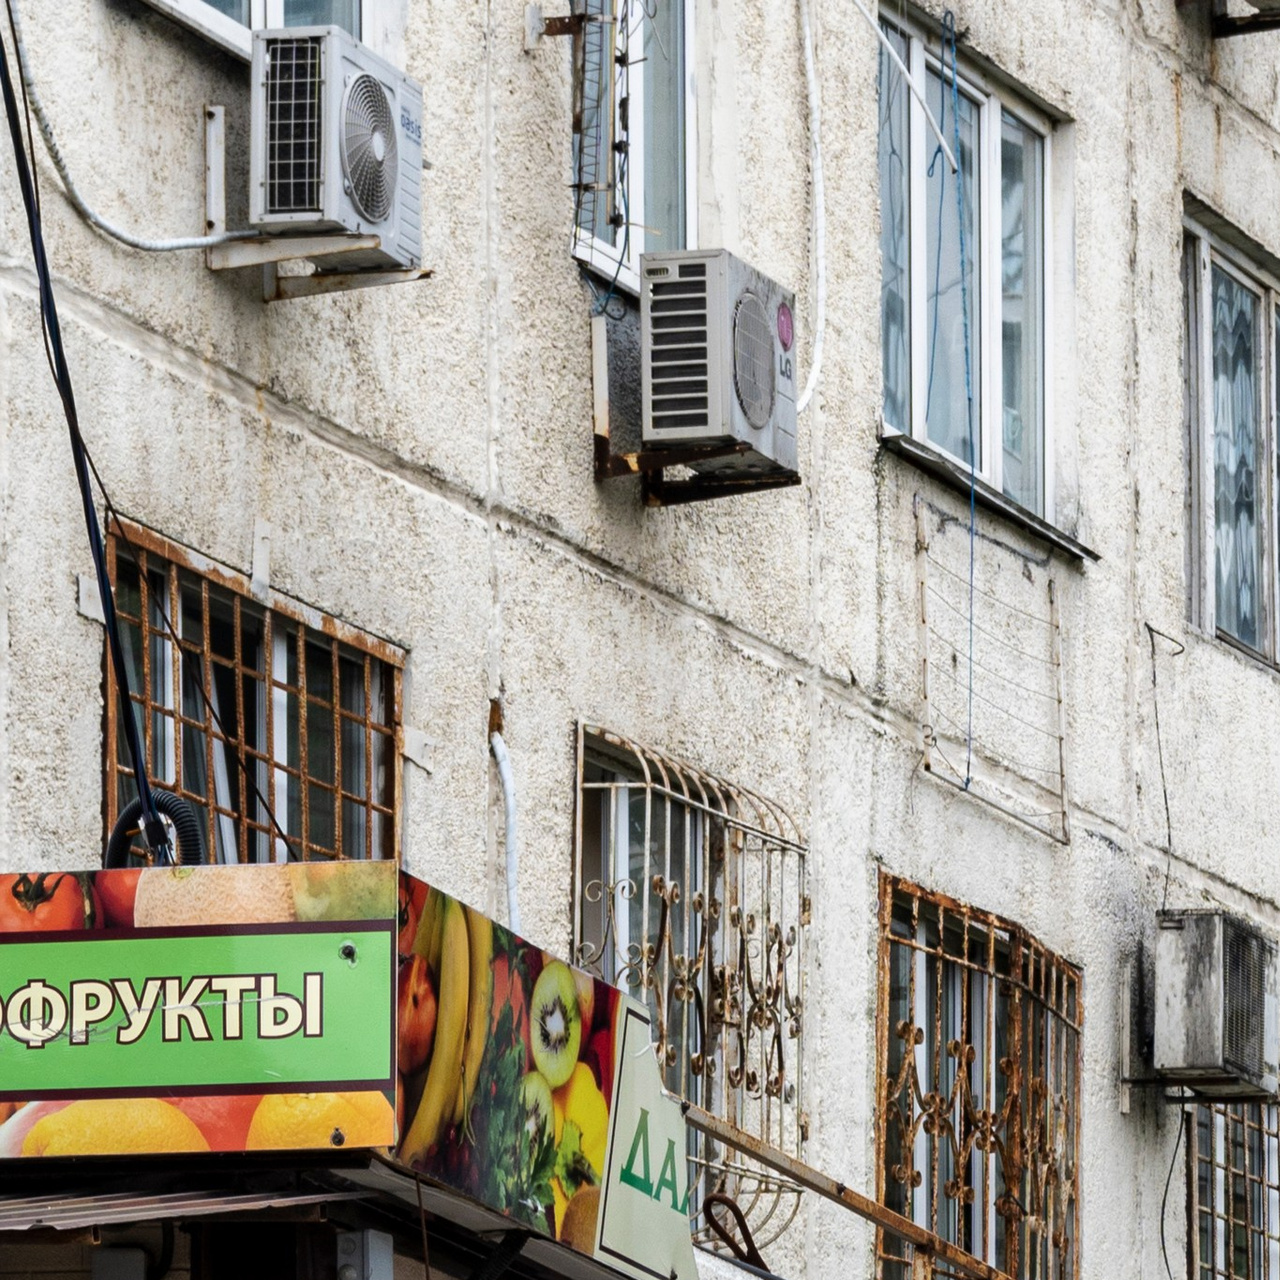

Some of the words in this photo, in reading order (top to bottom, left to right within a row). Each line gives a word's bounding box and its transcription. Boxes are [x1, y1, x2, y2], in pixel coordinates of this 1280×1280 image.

[779, 354, 792, 380] LG
[0, 971, 325, 1050] ФРУКТЫ
[618, 1107, 690, 1216] ДА
